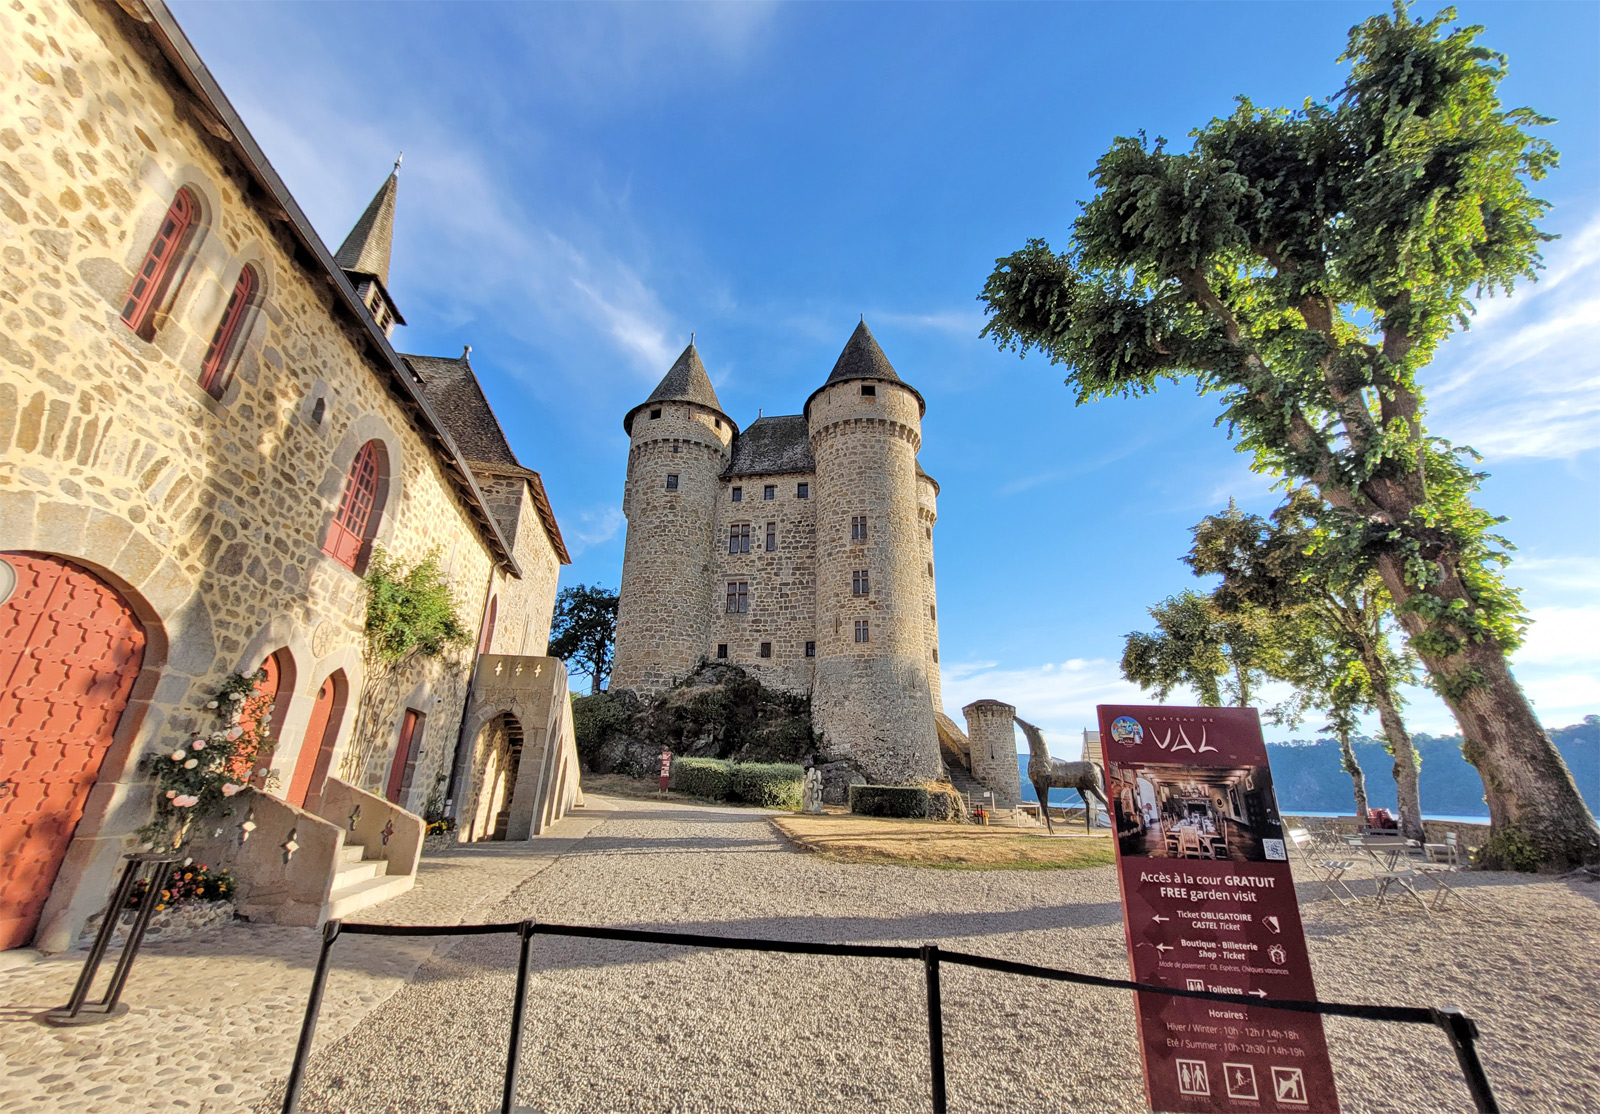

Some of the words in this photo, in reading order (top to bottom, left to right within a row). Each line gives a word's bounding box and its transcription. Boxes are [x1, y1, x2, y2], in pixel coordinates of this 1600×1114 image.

[1149, 724, 1218, 753] VAL
[1140, 872, 1172, 883] Accès
[1174, 872, 1181, 884] à
[1183, 873, 1193, 884] la
[1196, 876, 1221, 886] cour
[1224, 876, 1275, 888] GRATUIT
[1160, 887, 1188, 898] FREE
[1190, 889, 1230, 901] garden
[1232, 891, 1257, 902] visit
[1176, 910, 1200, 919] Ticket
[1201, 911, 1252, 922] OBLIGATOIRE
[1192, 920, 1218, 930] CASTEL
[1219, 922, 1240, 931] Ticket
[1181, 939, 1216, 949] Boutique
[1222, 941, 1258, 951] Billeterie
[1198, 951, 1216, 960] Shop
[1223, 952, 1245, 960] Ticket
[1207, 985, 1243, 995] Toilettes
[1208, 1009, 1243, 1019] Horaires
[1167, 1023, 1186, 1032] Hiver
[1192, 1024, 1217, 1034] Winter
[1224, 1026, 1238, 1035] 10h
[1245, 1028, 1260, 1037] 12h
[1267, 1029, 1299, 1040] 14h-18h
[1185, 1040, 1217, 1050] Summer
[1224, 1042, 1265, 1054] 10h-12h30
[1273, 1046, 1305, 1057] 14h-19h
